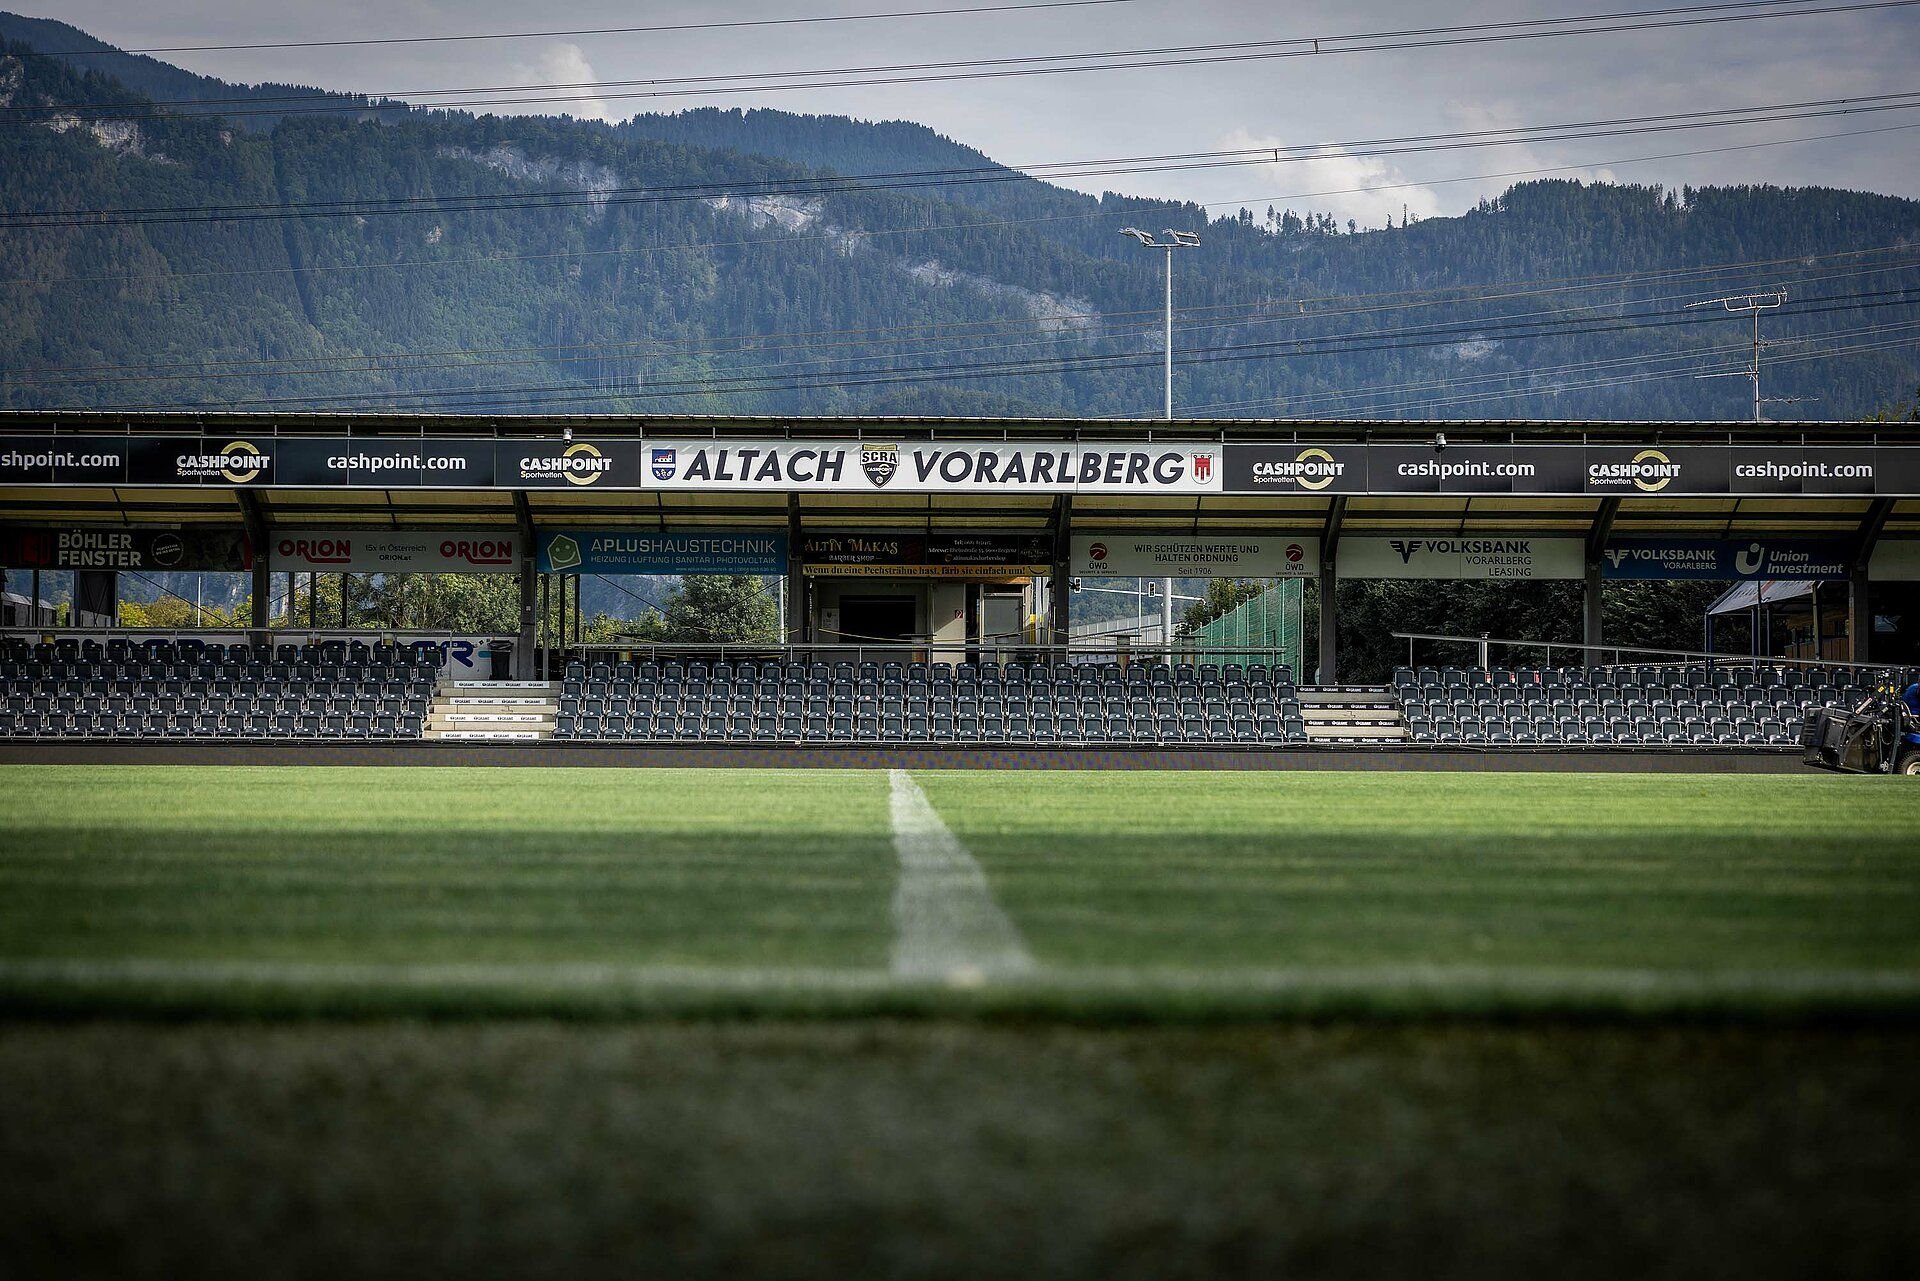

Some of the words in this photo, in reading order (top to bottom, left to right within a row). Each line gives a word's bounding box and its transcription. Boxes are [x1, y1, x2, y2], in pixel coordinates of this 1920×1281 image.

[1, 450, 120, 471] shpoint.com
[176, 455, 270, 469] CASHPOINT
[327, 453, 466, 473] cashpoint.com
[862, 451, 898, 464] SCRA
[519, 457, 612, 471] CASHPOINT
[683, 450, 846, 482] ALTACH
[913, 451, 1185, 485] VORARLBERG
[1252, 462, 1344, 476] CASHPOINT
[1397, 460, 1535, 479] cashpoint.com
[1588, 463, 1681, 477] CASHPOINT
[176, 468, 220, 476] Sportwetten
[520, 470, 563, 479] Sportwetten
[1735, 461, 1873, 480] cashpoint.com
[1253, 475, 1295, 484] Sportwetten
[1589, 476, 1632, 485] Sportwetten
[58, 529, 132, 549] BÖHLER
[278, 540, 351, 563] ORION
[591, 539, 776, 553] APLUSHAUSTECHNIK
[1134, 544, 1152, 553] WIR
[1154, 543, 1203, 553] SCHÜTZEN
[1205, 545, 1237, 553] WERTE
[1239, 545, 1260, 554] UND
[1425, 541, 1531, 554] VOLKSBANK
[58, 551, 142, 566] FENSTER
[439, 541, 512, 564] ORION
[1155, 554, 1191, 562] HALTEN
[1193, 554, 1239, 562] ORDNUNG
[1632, 550, 1716, 560] VOLKSBANK
[1770, 551, 1809, 562] Union
[716, 556, 776, 564] PHOTOVOLTAIK
[1089, 561, 1108, 570] ÖWD
[1465, 557, 1532, 565] VORARLBERG
[1663, 562, 1717, 570] VORARLBERG
[805, 565, 829, 575] Wenn
[831, 566, 842, 575] du
[845, 566, 862, 575] eine
[976, 567, 1007, 576] einfach
[1178, 567, 1194, 575] Seit
[1195, 567, 1212, 575] 1906
[1285, 563, 1304, 571] ÖWD
[1488, 568, 1532, 577] LEASING
[1767, 563, 1844, 574] Investment
